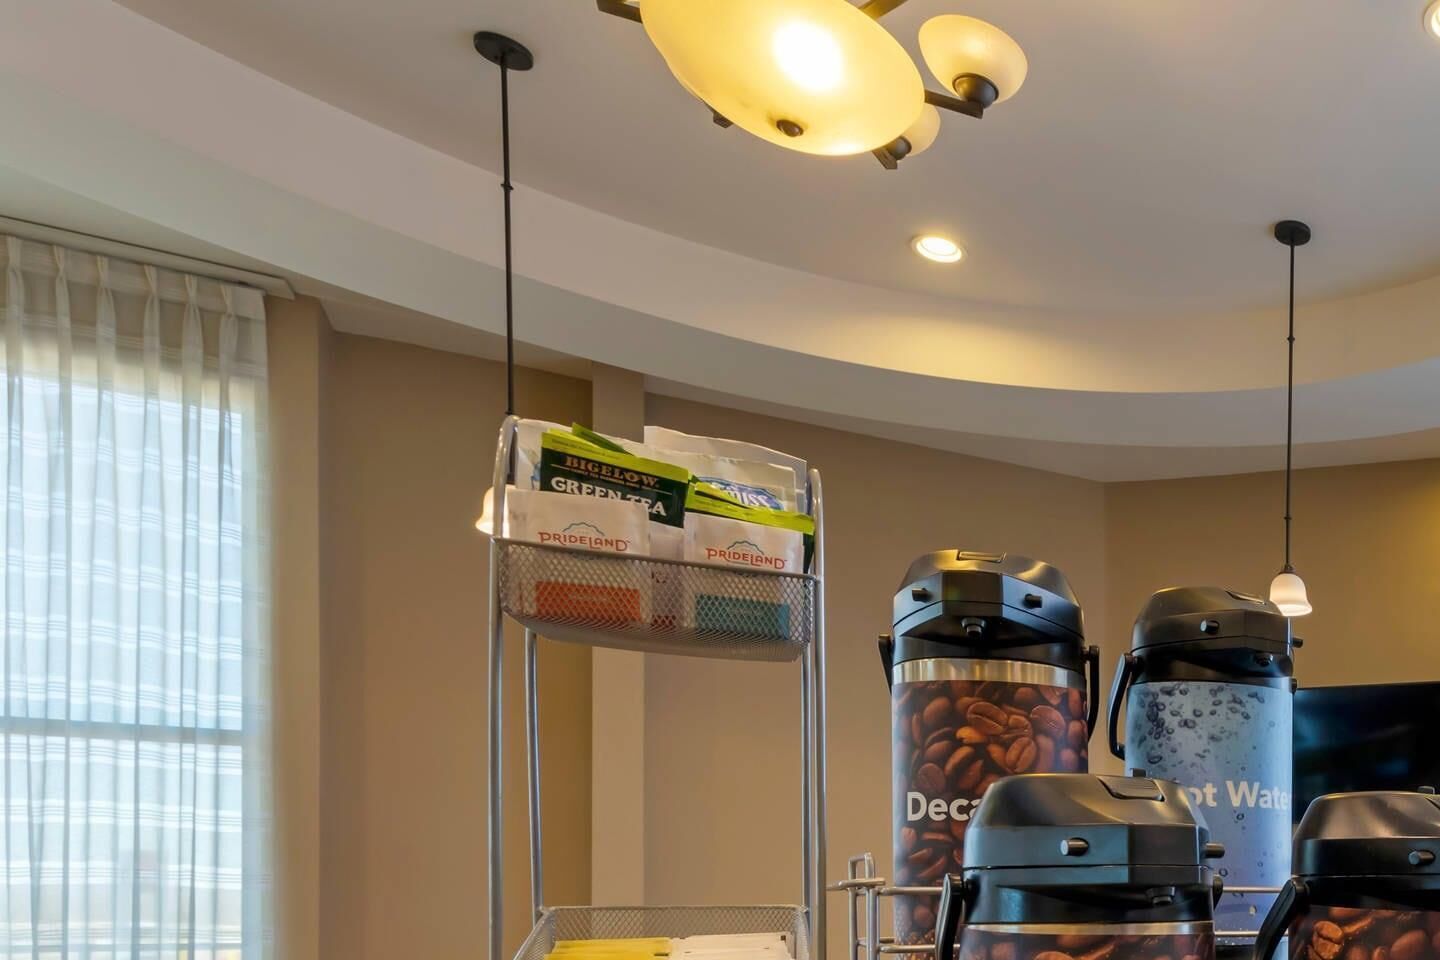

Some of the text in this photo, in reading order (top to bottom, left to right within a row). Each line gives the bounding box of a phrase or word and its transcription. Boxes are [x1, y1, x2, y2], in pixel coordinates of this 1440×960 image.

[565, 456, 657, 487] BIGELOW
[551, 477, 622, 501] GREEN
[537, 531, 628, 552] PRIDELAND
[705, 548, 785, 569] PRIDELAND
[1226, 780, 1292, 810] Wate
